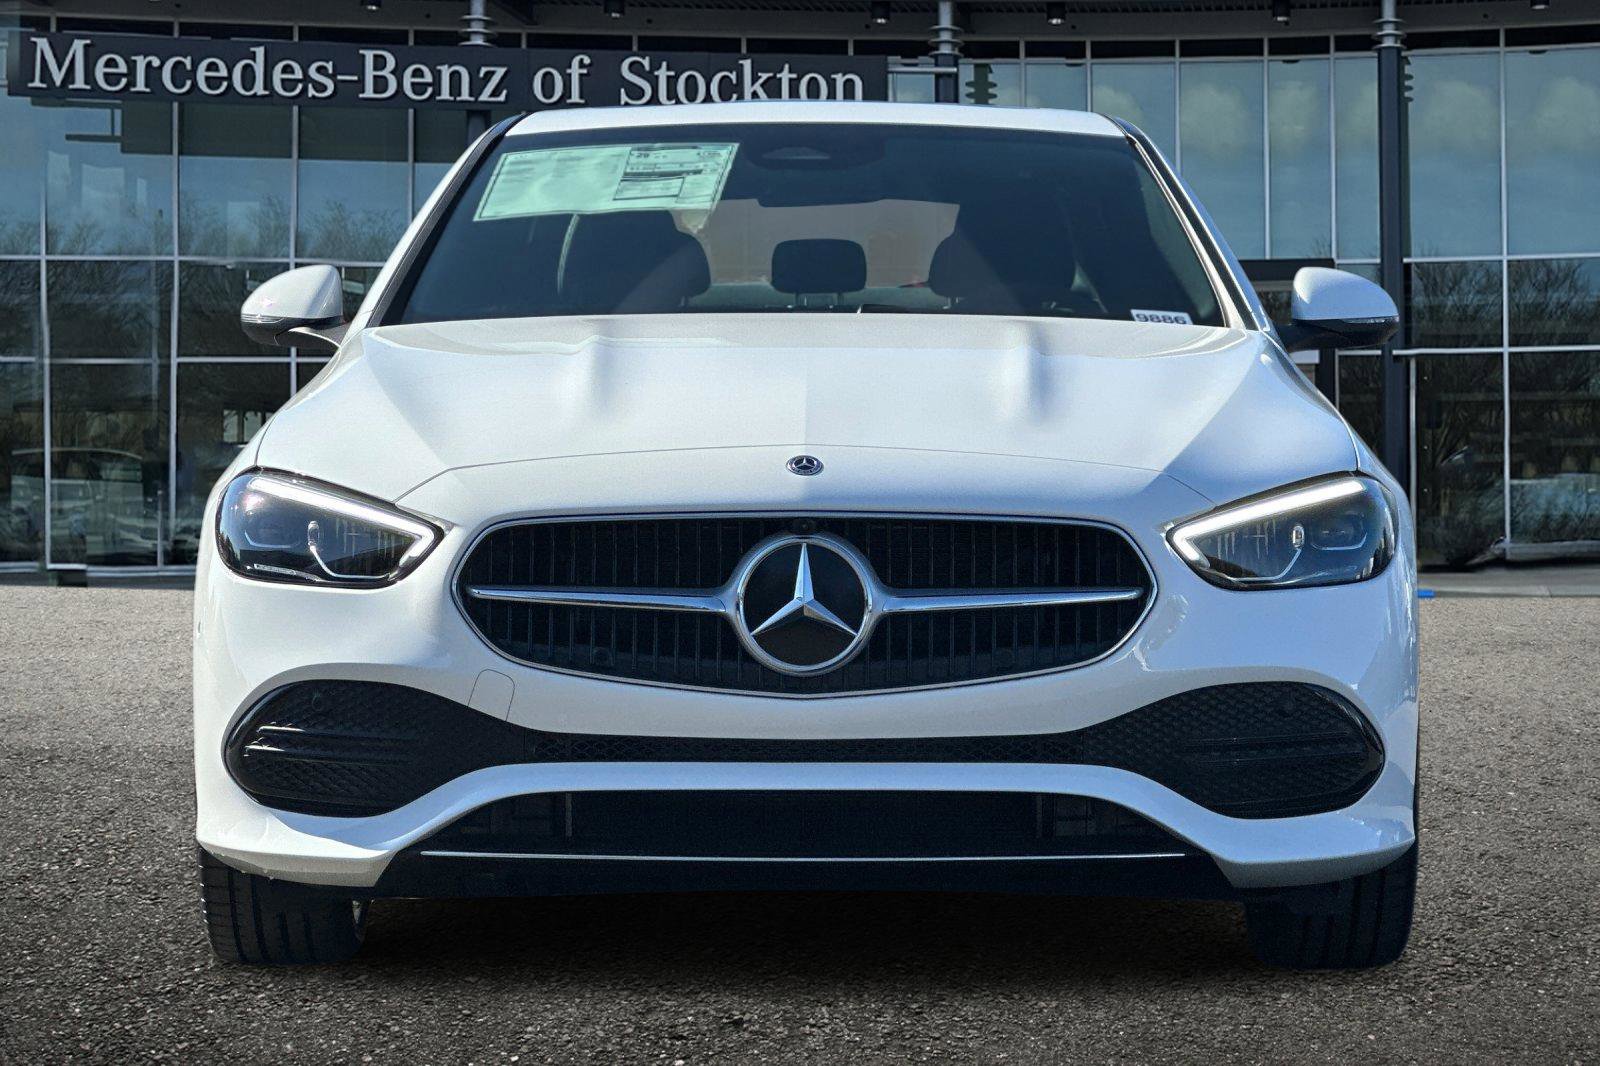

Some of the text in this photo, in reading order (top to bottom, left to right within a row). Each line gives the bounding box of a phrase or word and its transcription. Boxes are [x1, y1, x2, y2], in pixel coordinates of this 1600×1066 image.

[27, 37, 863, 105] Mercedes-Benz of Stockton
